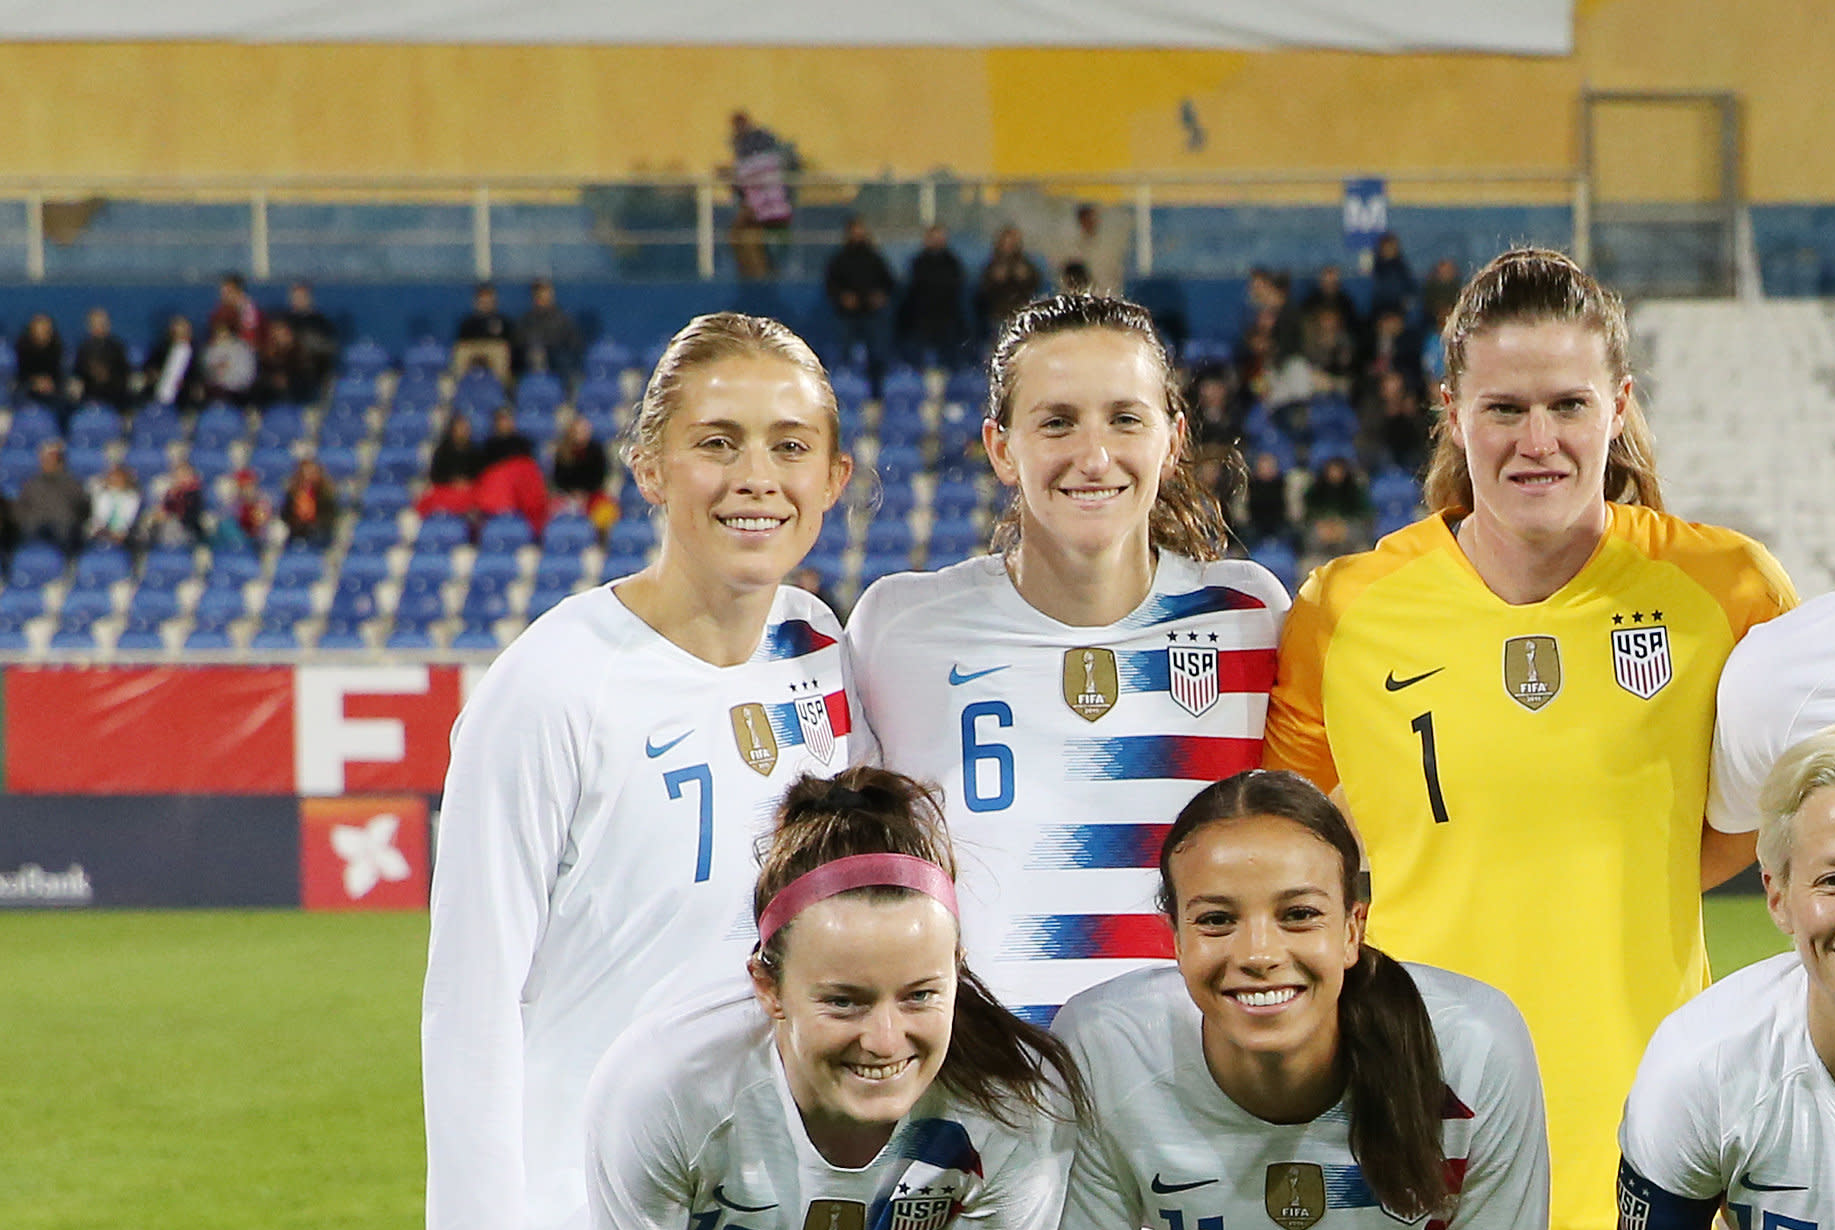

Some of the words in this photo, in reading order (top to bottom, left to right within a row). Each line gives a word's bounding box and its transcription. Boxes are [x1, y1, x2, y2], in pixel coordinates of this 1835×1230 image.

[1343, 194, 1386, 231] M
[1617, 631, 1663, 658] USA
[1173, 652, 1215, 677] USA
[1078, 694, 1106, 704] FIFA
[1520, 682, 1548, 693] FIFA
[797, 700, 824, 726] USA
[961, 700, 1016, 813] 6
[1410, 711, 1450, 824] 1
[663, 763, 714, 884] 7
[897, 1201, 947, 1220] USA
[1282, 1207, 1309, 1217] FIFA
